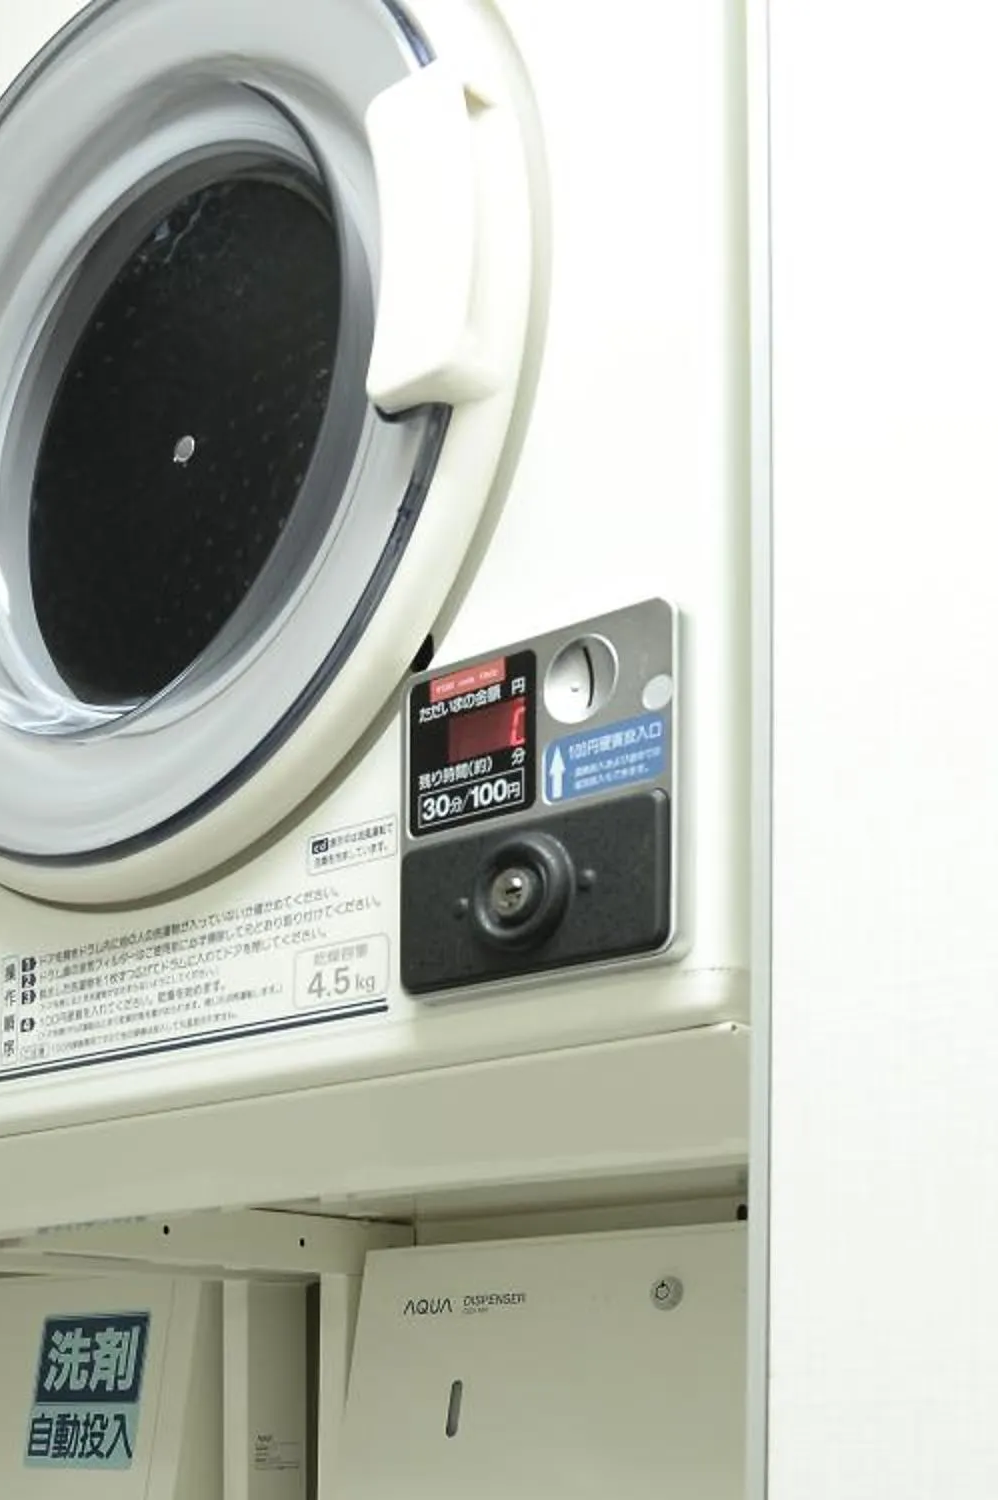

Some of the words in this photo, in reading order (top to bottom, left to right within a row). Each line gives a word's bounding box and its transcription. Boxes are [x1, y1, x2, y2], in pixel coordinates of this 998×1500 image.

[511, 676, 526, 695] 円
[511, 747, 526, 766] 分
[403, 1297, 452, 1315] AQUA
[43, 1325, 141, 1392] 洗剤
[27, 1412, 133, 1459] 自動投入
